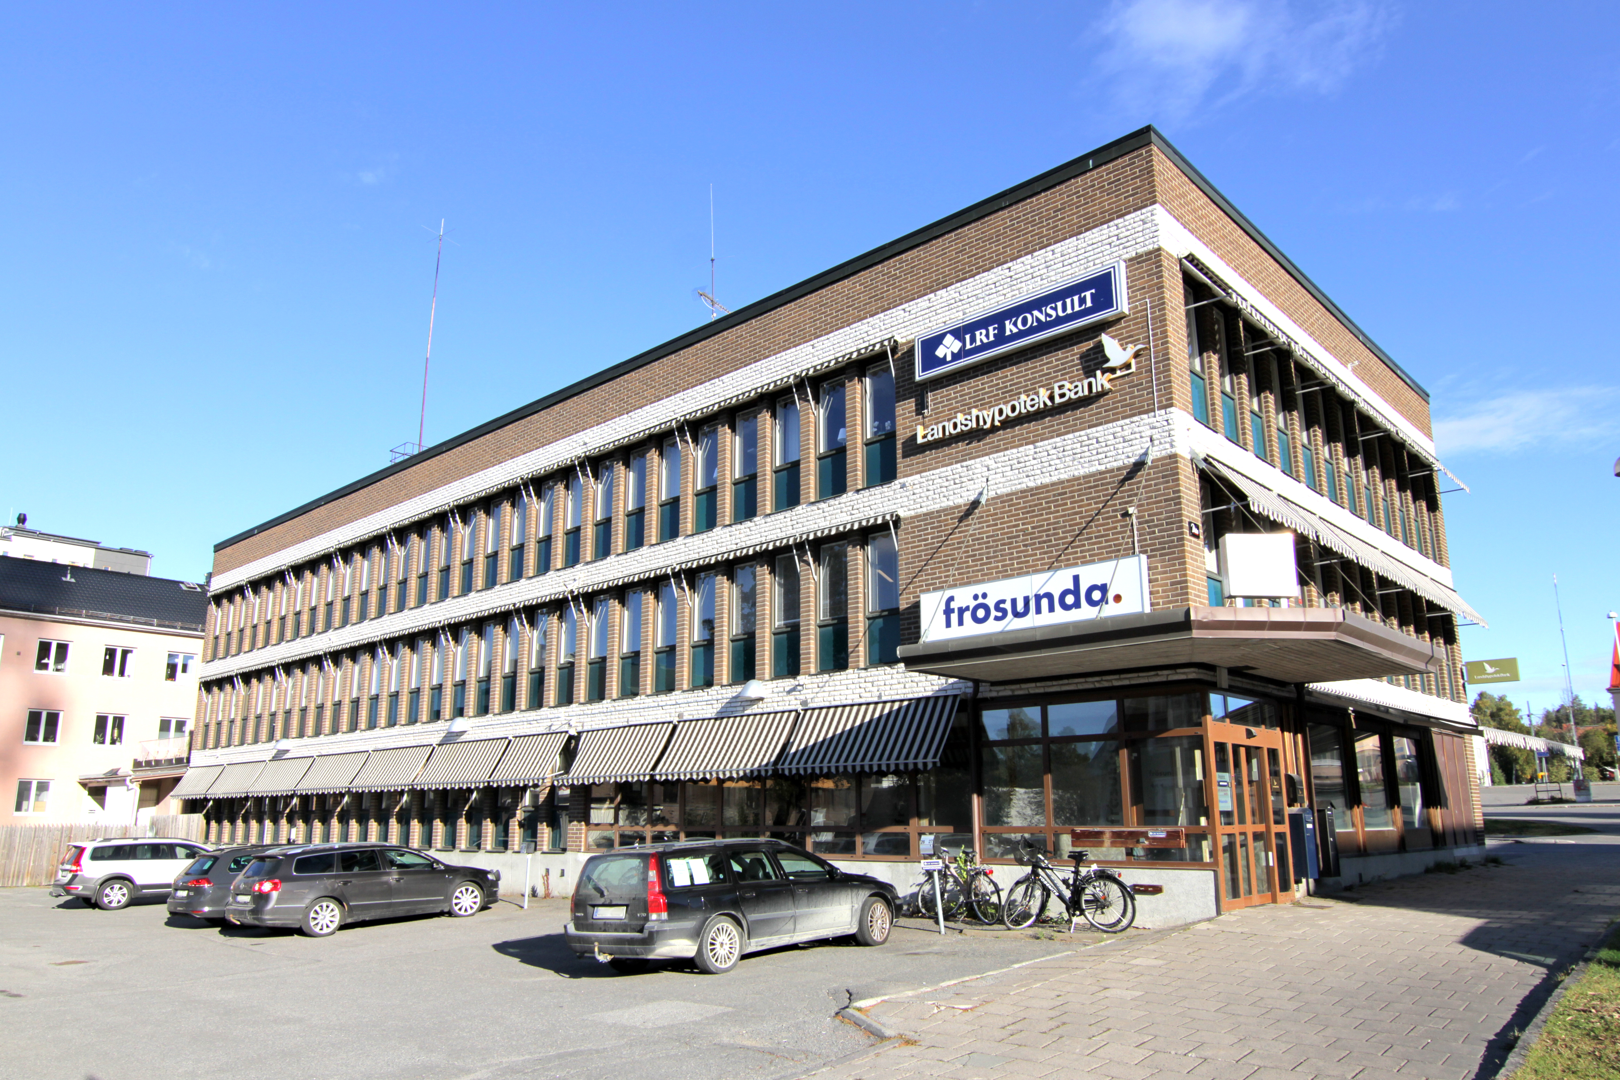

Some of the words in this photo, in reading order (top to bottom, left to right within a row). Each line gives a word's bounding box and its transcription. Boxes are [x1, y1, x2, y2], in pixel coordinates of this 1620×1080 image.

[964, 324, 998, 350] LRF
[1004, 288, 1096, 337] KONSULT
[916, 387, 1052, 445] Landshypotek
[1054, 370, 1114, 405] Bank
